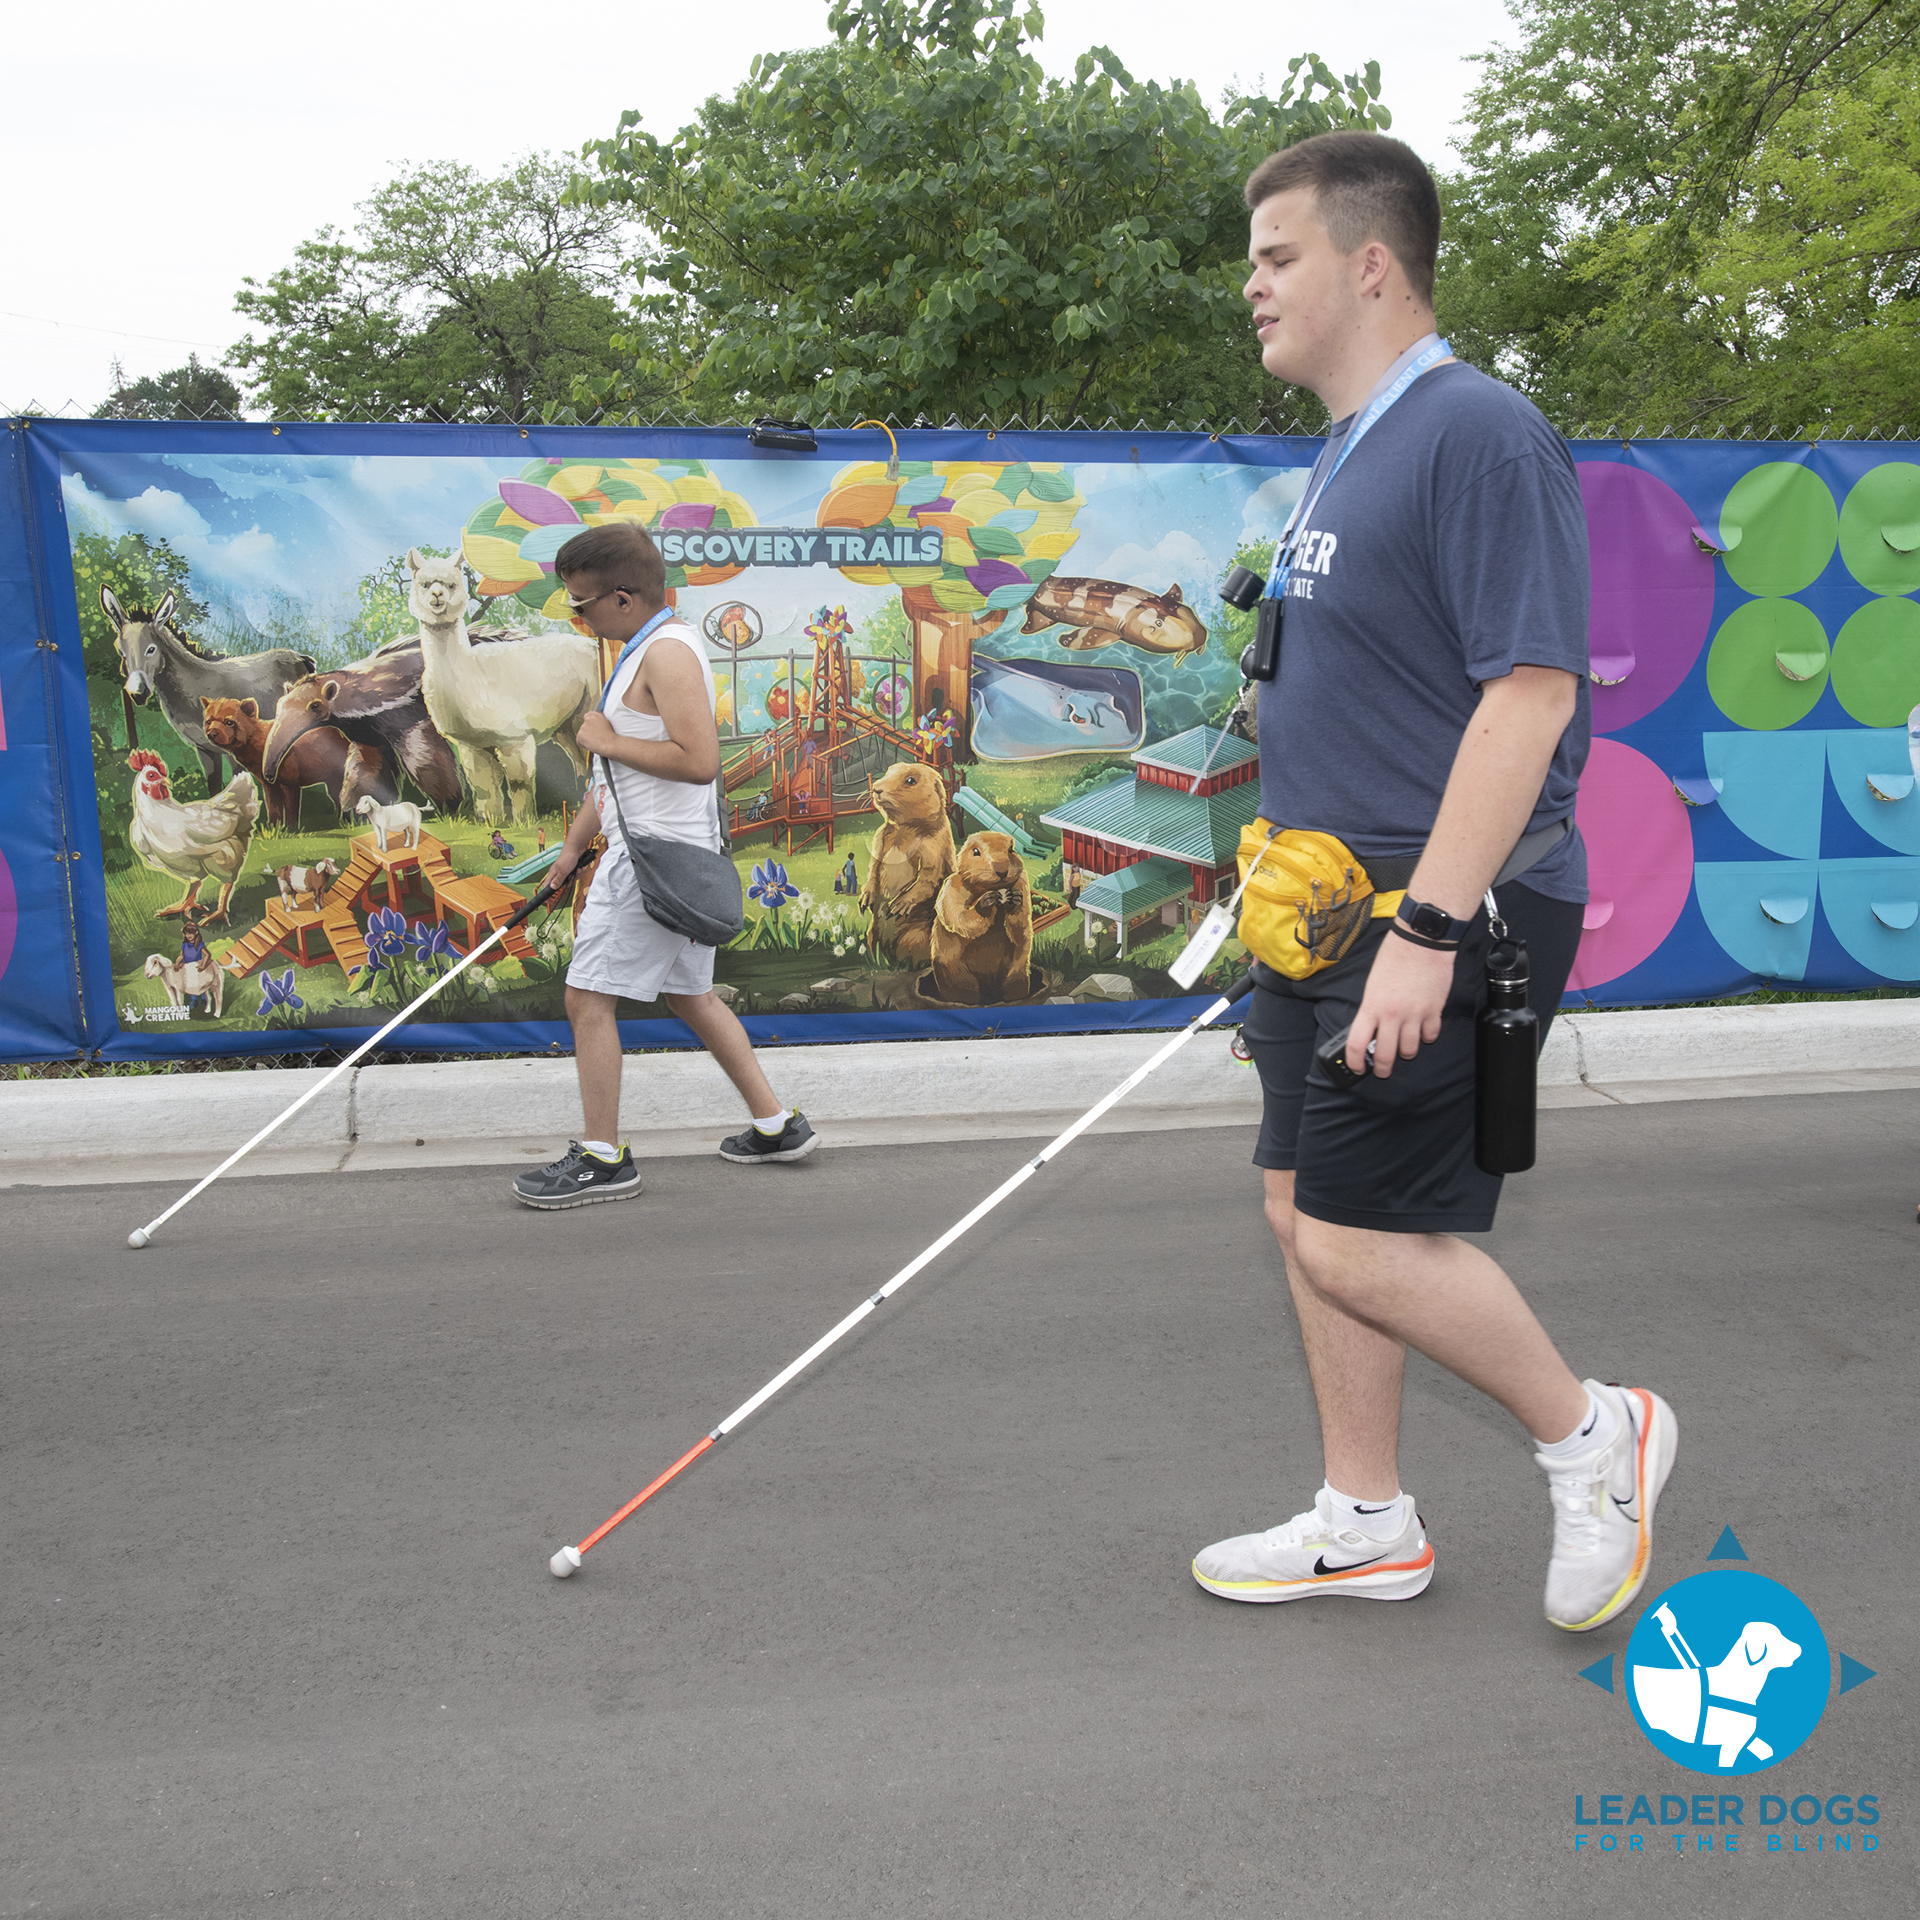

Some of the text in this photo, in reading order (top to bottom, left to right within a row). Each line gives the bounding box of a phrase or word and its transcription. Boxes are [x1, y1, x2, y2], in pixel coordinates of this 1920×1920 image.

[1349, 343, 1447, 447] CLIENT CLIENT CLIENT
[826, 535, 941, 562] TRAILS
[624, 614, 663, 655] CLIENT CLIENT
[144, 1005, 190, 1014] MANGOLIN
[145, 1012, 191, 1022] CREATIVE
